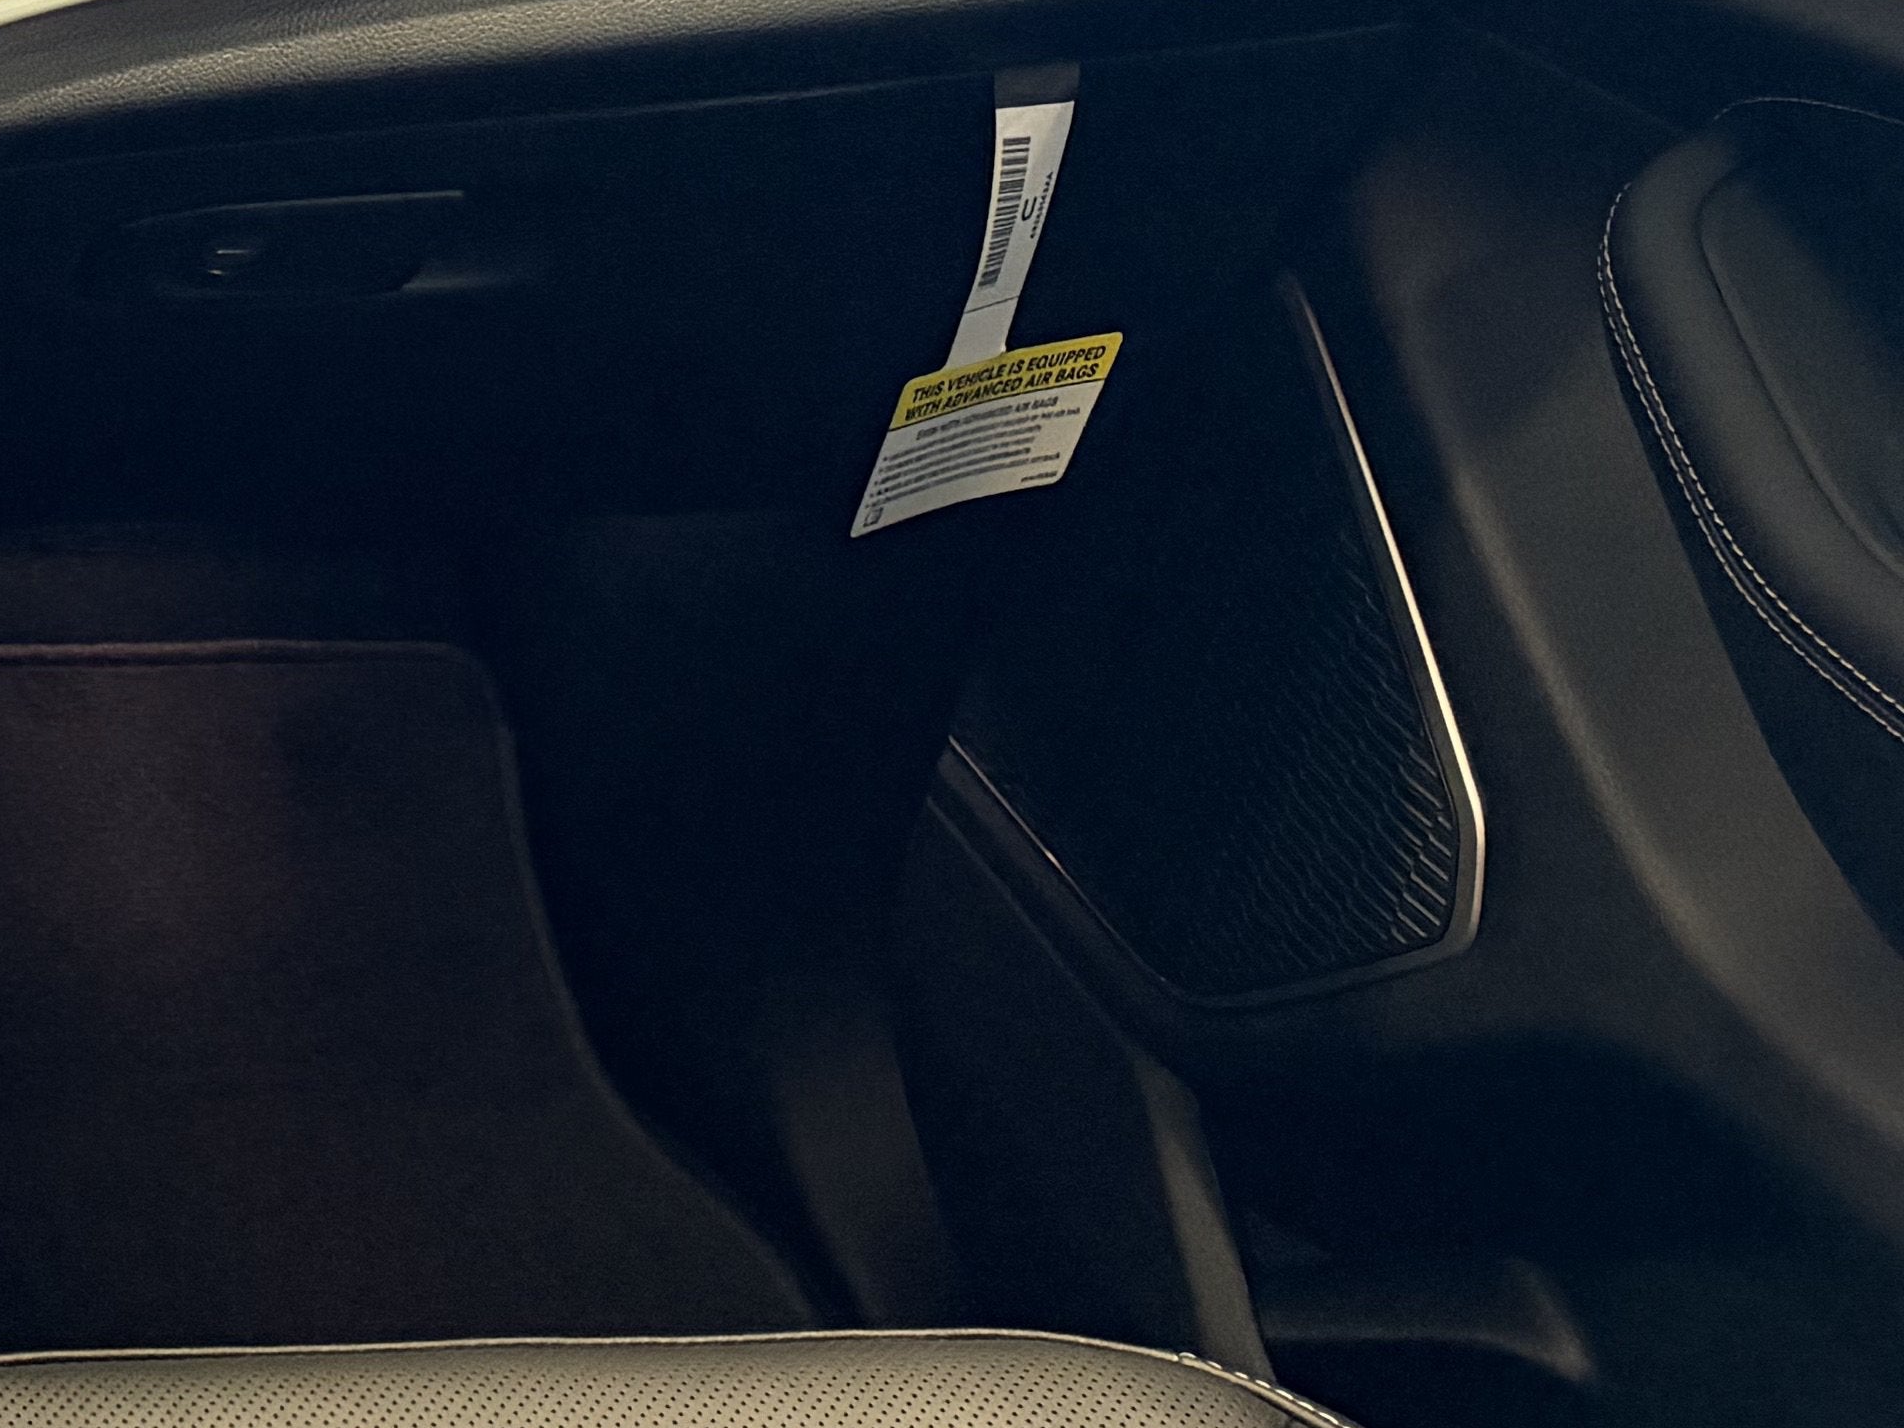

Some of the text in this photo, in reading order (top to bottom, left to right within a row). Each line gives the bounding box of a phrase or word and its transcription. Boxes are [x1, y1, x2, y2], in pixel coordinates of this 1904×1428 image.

[905, 363, 1100, 422] WITH ADVANCED AIR BAGS
[913, 345, 1106, 403] THIS VEHICLE IS EQUIPPED
